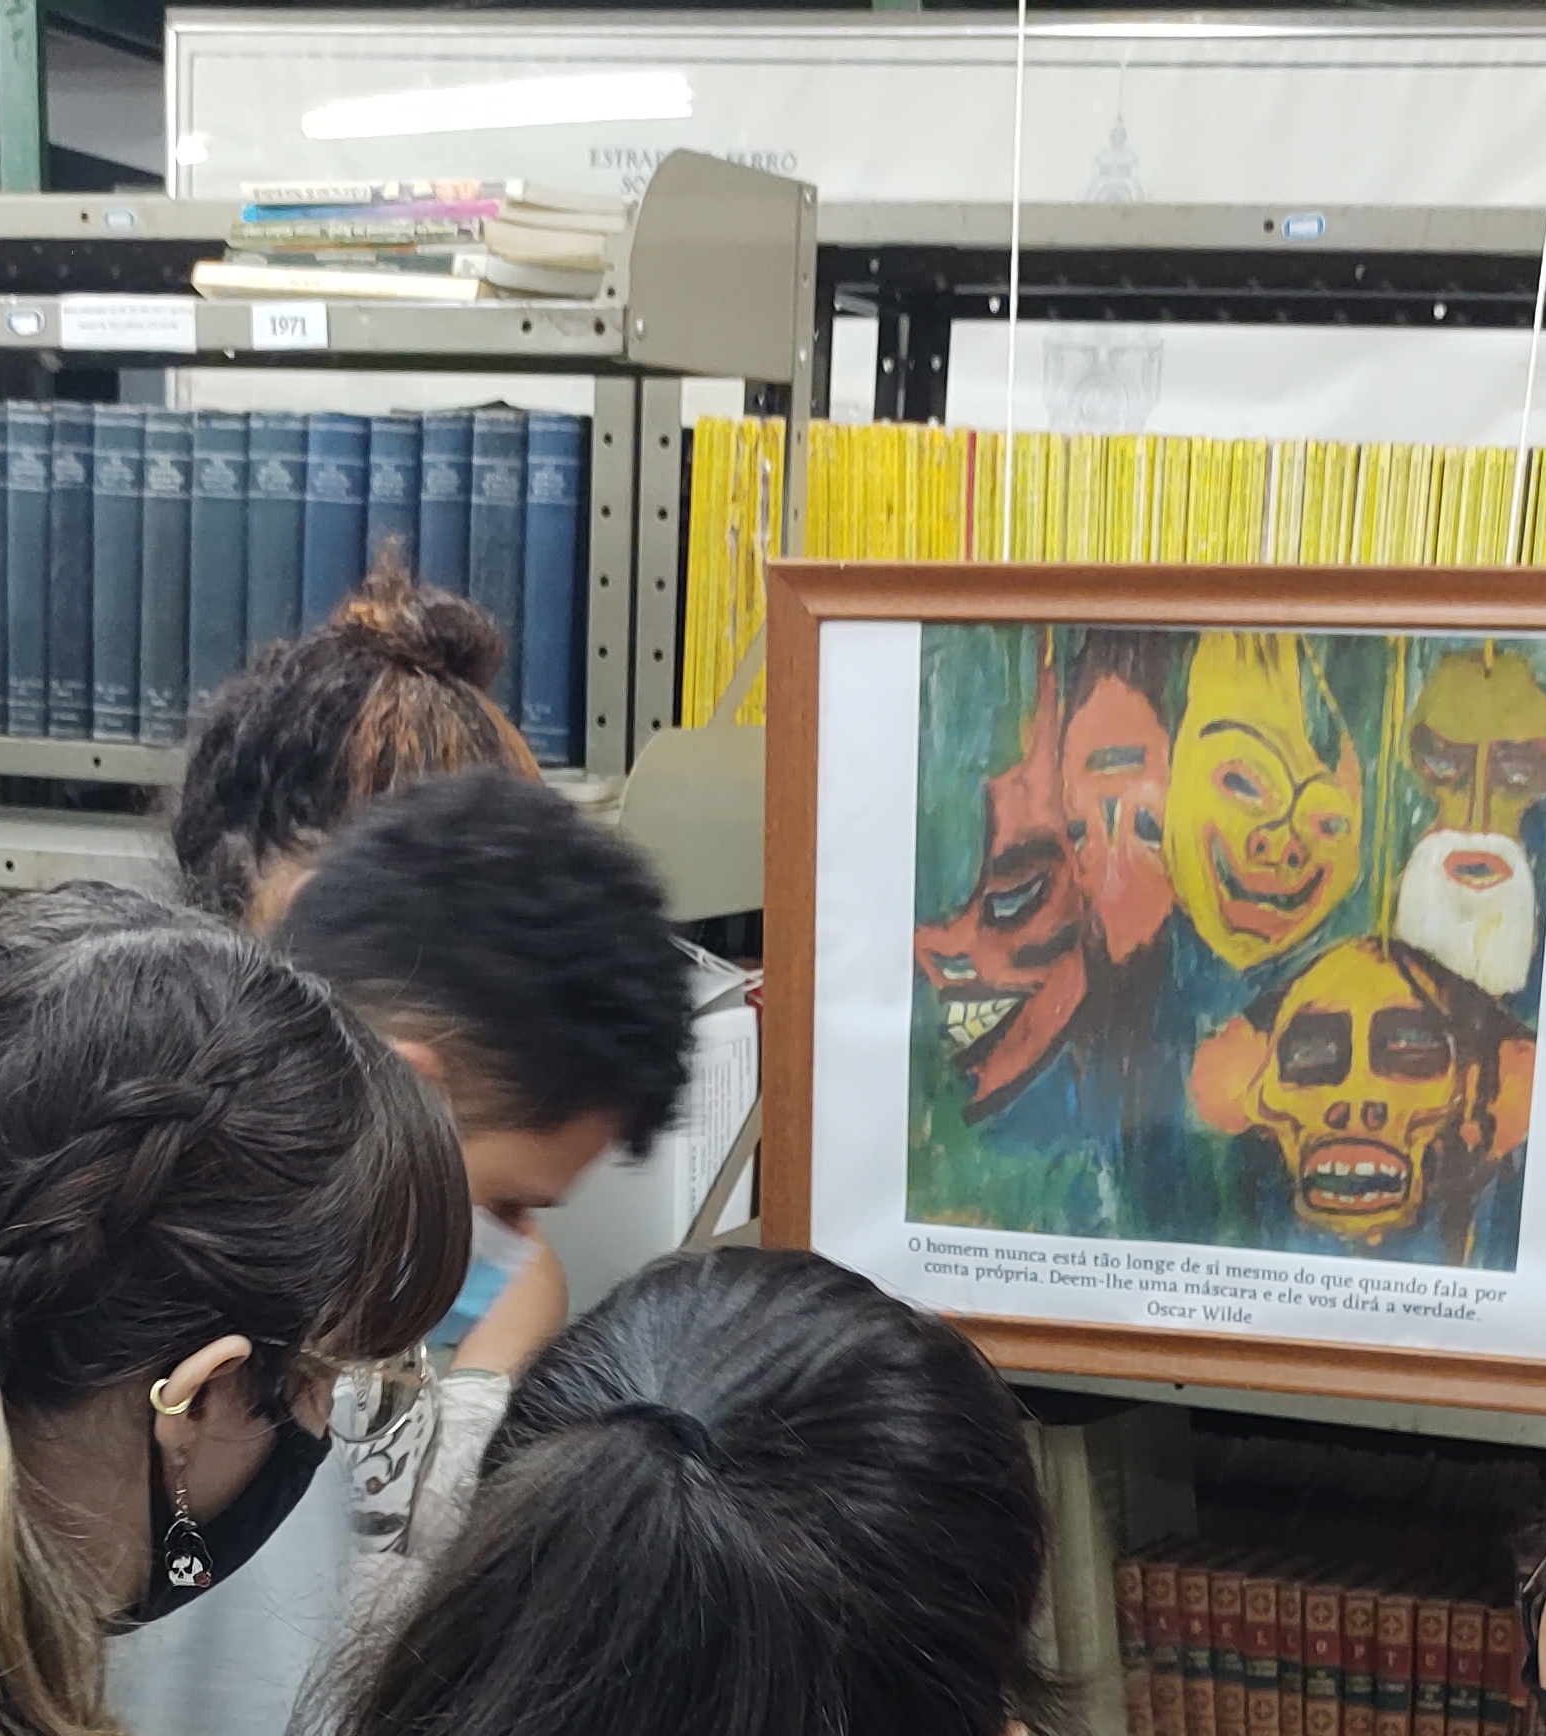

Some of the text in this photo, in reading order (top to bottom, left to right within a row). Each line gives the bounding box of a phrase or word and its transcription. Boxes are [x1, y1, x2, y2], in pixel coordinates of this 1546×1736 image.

[588, 150, 665, 168] ESTRA
[268, 314, 307, 338] 1971
[908, 1238, 1507, 1304] O homem nunca está tão longe de si mesmo do que quando fala por
[923, 1260, 1482, 1323] conta própria. Deem-lhe uma máscara e ele vos dirá a verdade.
[1146, 1300, 1253, 1325] Oscar Wilde
